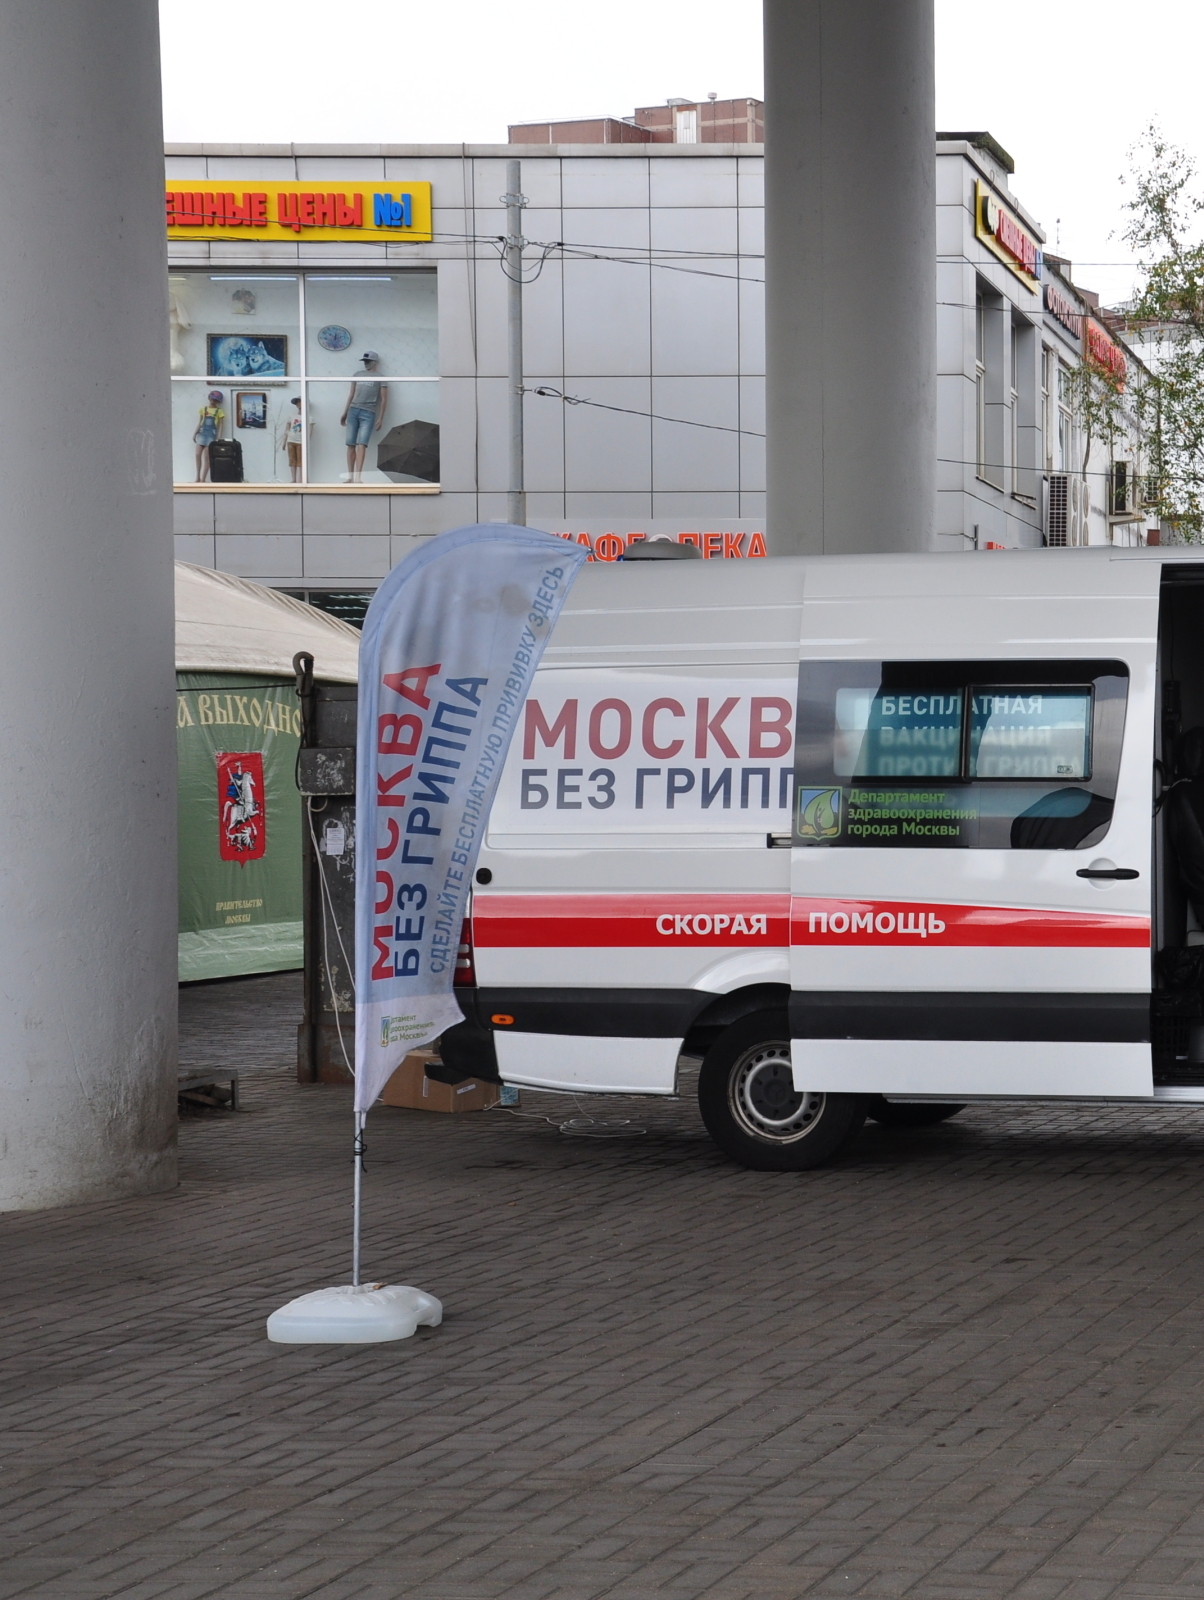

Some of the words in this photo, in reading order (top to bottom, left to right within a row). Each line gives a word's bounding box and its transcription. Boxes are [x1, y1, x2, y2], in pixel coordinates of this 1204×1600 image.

[277, 193, 363, 232] ЦЕНЫ
[373, 193, 412, 226] №1
[522, 697, 793, 760] МОСКВ
[401, 677, 488, 865] ГРИППА
[430, 867, 464, 973] СДЕЛАЙТЕ
[451, 733, 503, 866] БЕСПЛАТНУЮ
[492, 624, 537, 738] ПРИВИВКУ
[528, 565, 564, 627] ЗДЕСЬ
[520, 768, 616, 810] БЕЗ
[848, 789, 945, 805] Департамент
[848, 808, 977, 822] здравоохранения
[848, 824, 898, 837] города
[902, 822, 960, 836] Москвы
[394, 883, 428, 977] БЕЗ
[656, 914, 767, 935] СКОРАЯ
[808, 912, 946, 938] ПОМОЩЬ
[399, 1031, 428, 1040] Москвы
